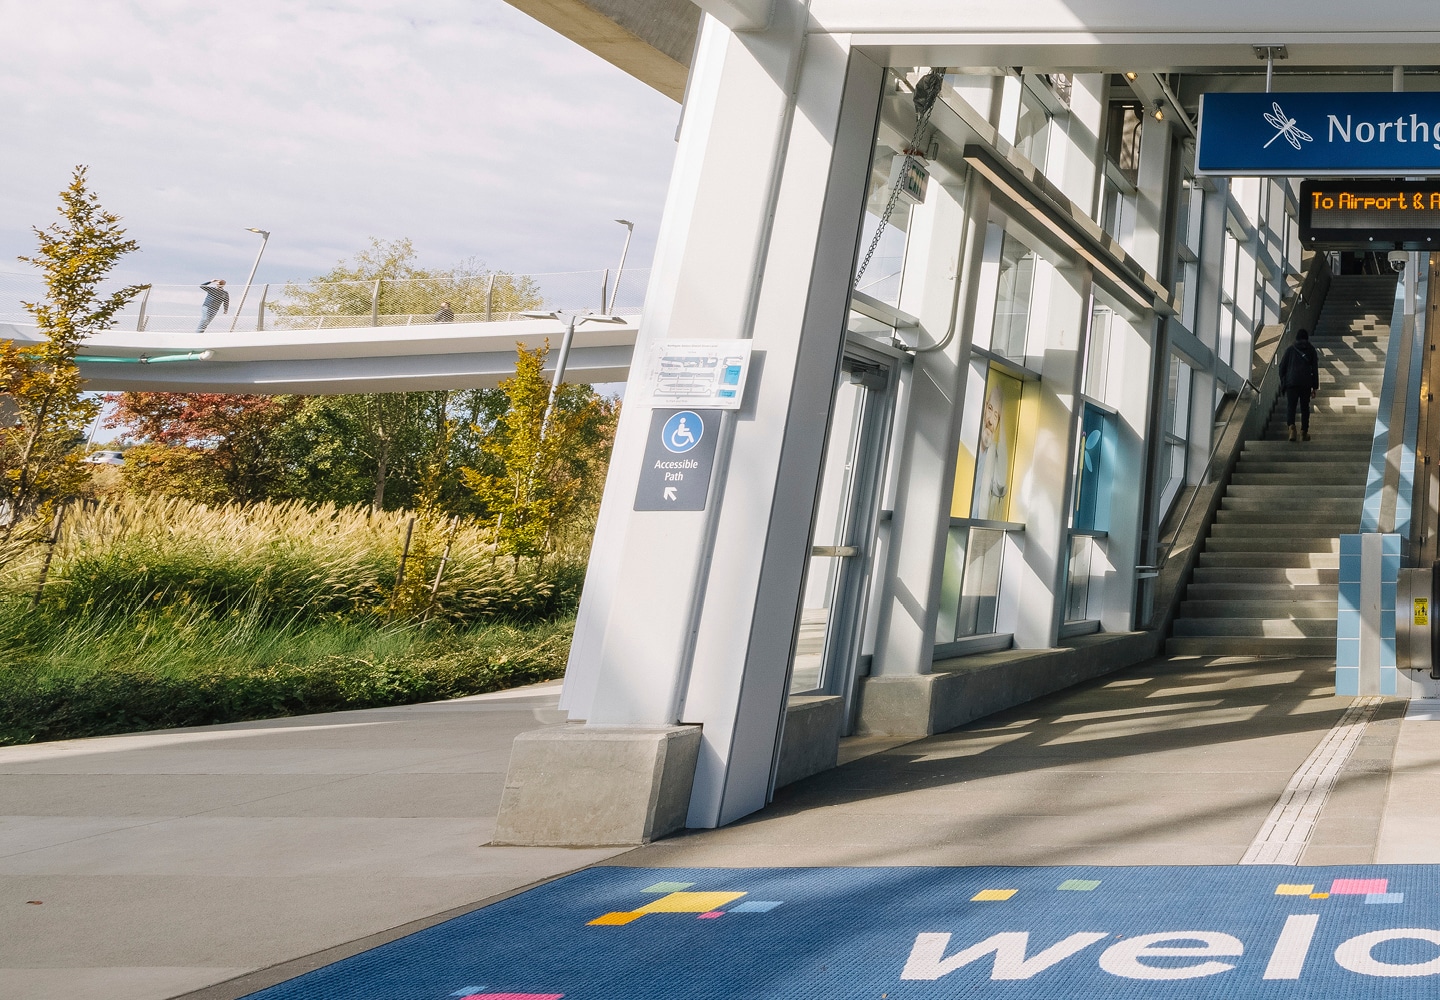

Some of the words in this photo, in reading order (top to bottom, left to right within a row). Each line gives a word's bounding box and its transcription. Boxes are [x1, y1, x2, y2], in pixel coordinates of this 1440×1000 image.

[908, 164, 926, 197] EXIT
[1311, 192, 1334, 210] To
[1338, 192, 1408, 210] Airport
[1413, 192, 1425, 210] &
[653, 459, 699, 469] Accessible
[664, 471, 684, 481] Path
